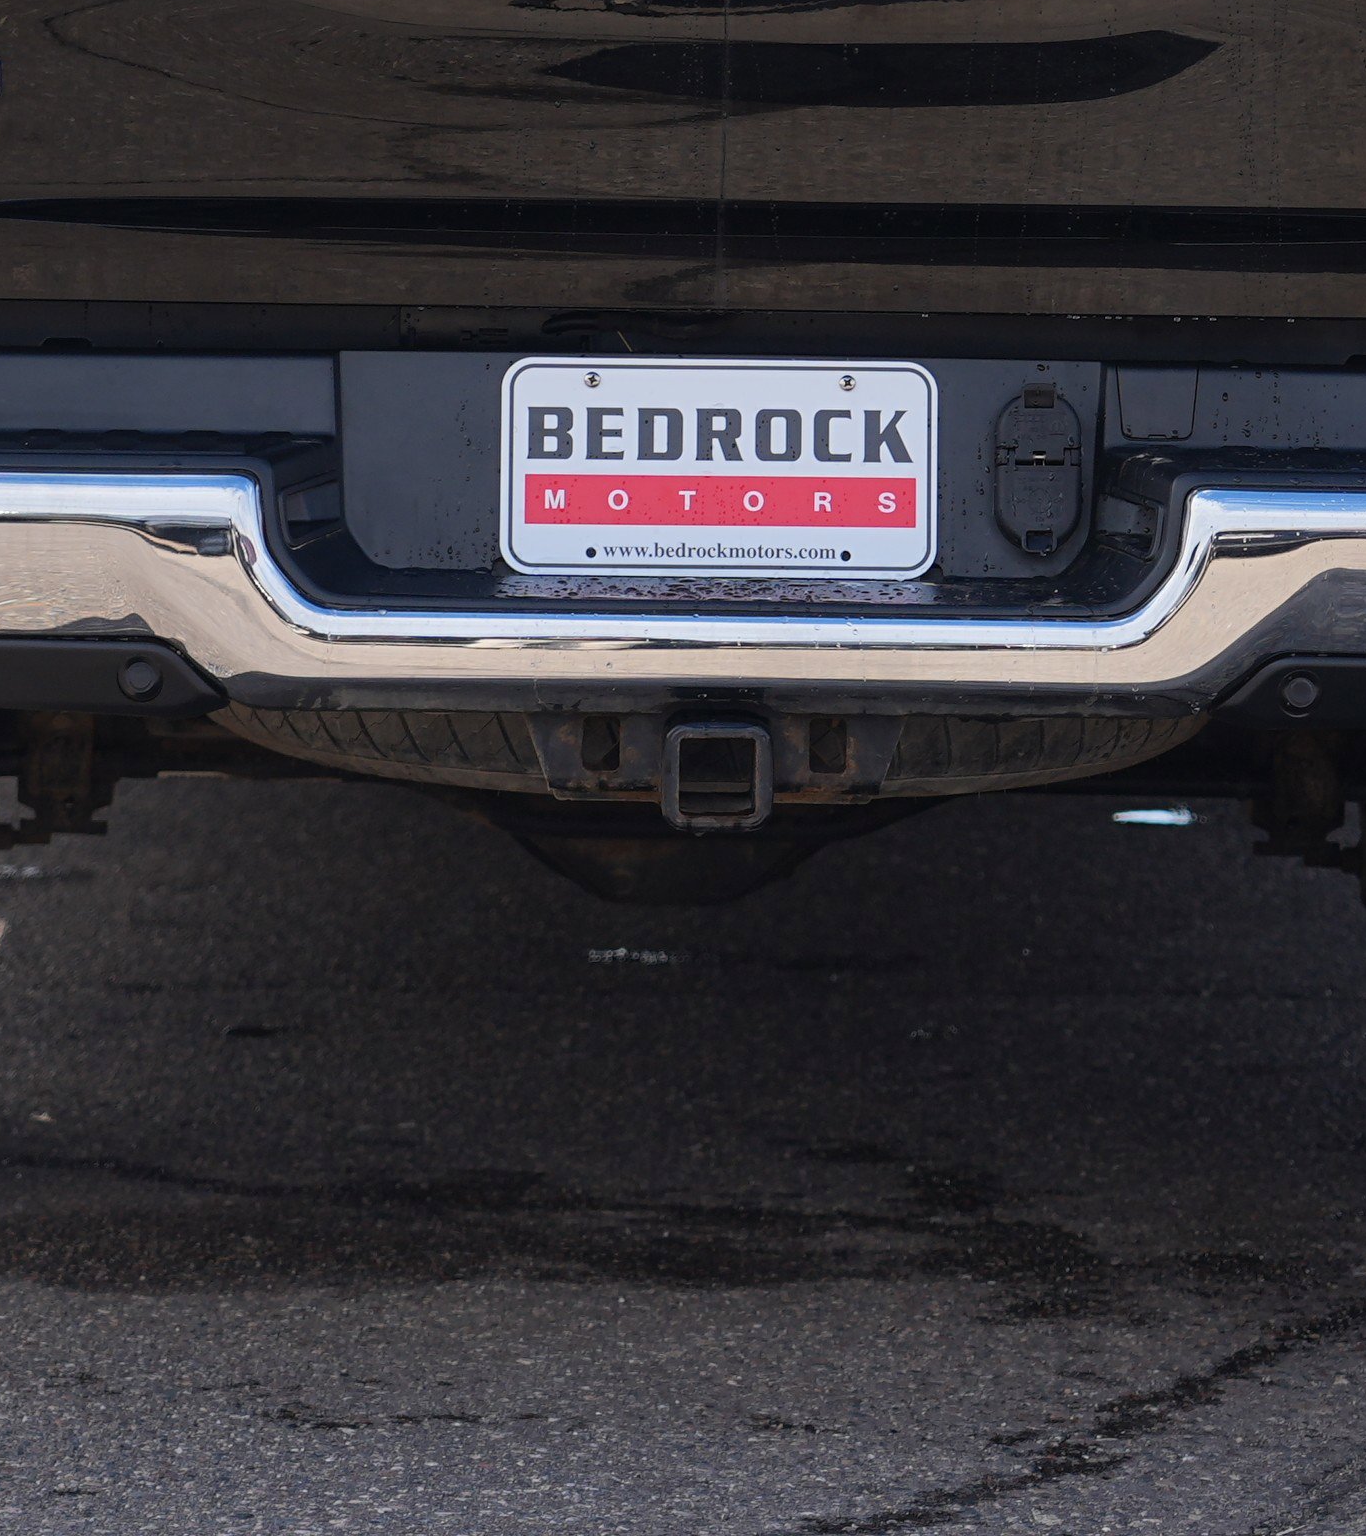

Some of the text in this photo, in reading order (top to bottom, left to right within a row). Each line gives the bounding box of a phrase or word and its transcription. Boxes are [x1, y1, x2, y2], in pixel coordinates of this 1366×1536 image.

[526, 406, 914, 463] BEDROCK
[543, 489, 898, 514] MOTORS
[603, 542, 836, 562] www.bedrockmotors.com
